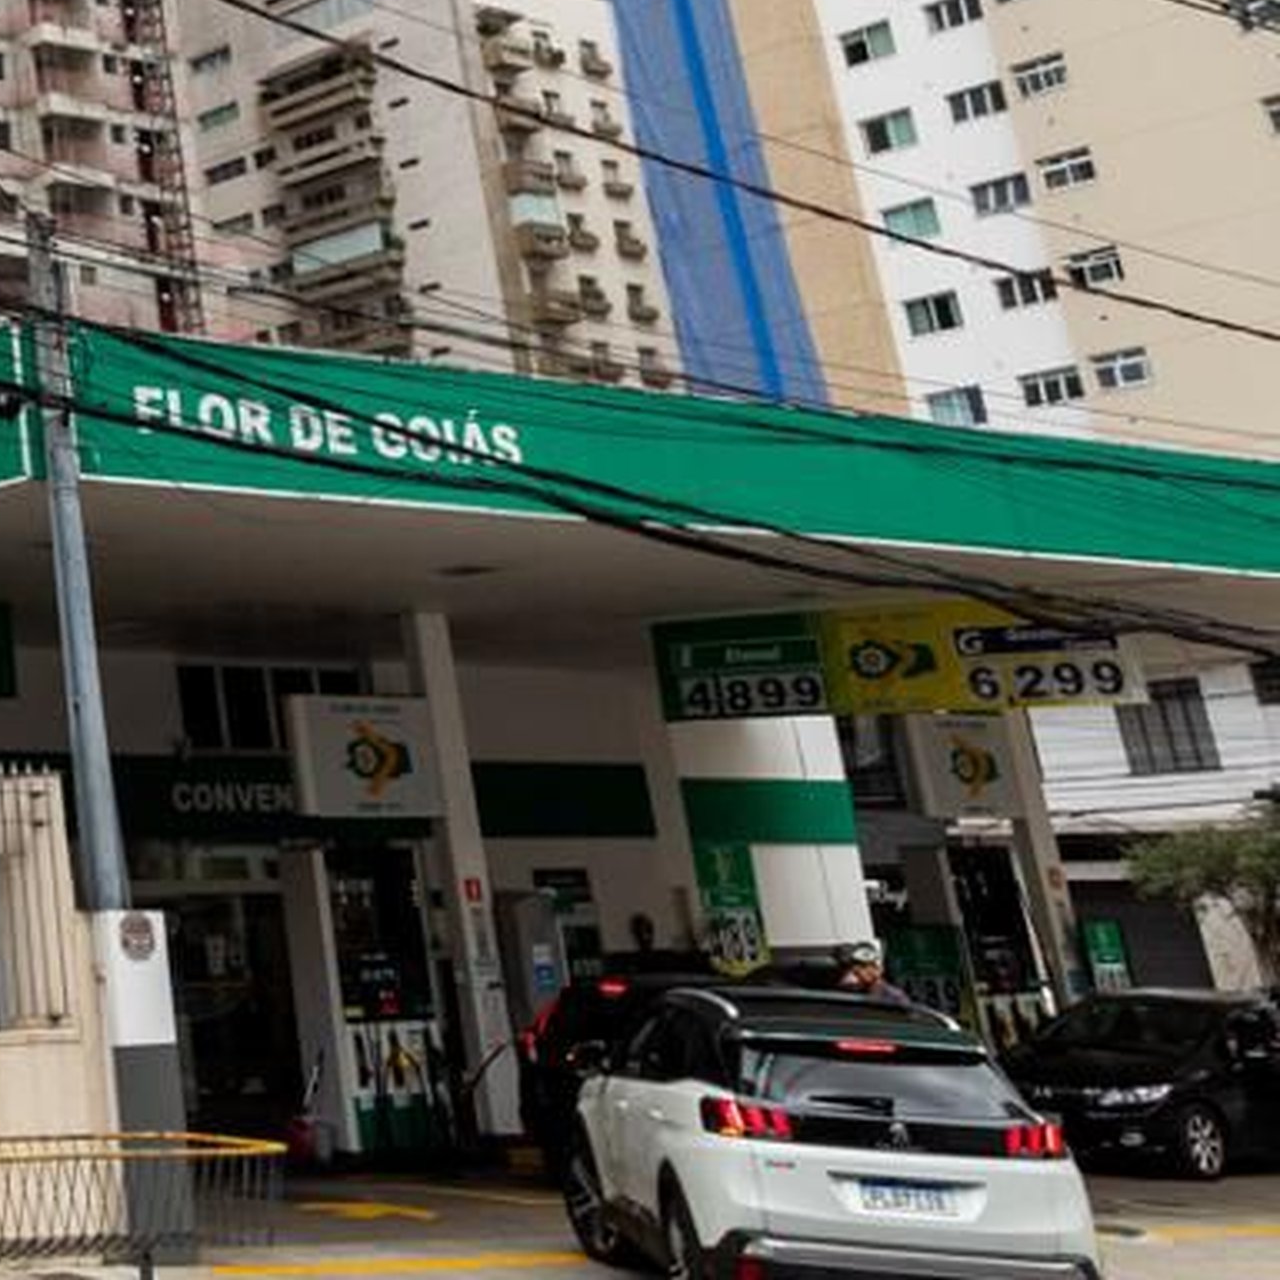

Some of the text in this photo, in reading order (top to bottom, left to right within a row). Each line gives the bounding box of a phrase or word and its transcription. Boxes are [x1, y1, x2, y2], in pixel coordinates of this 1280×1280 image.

[133, 385, 523, 465] FLOR DE GOIÁS
